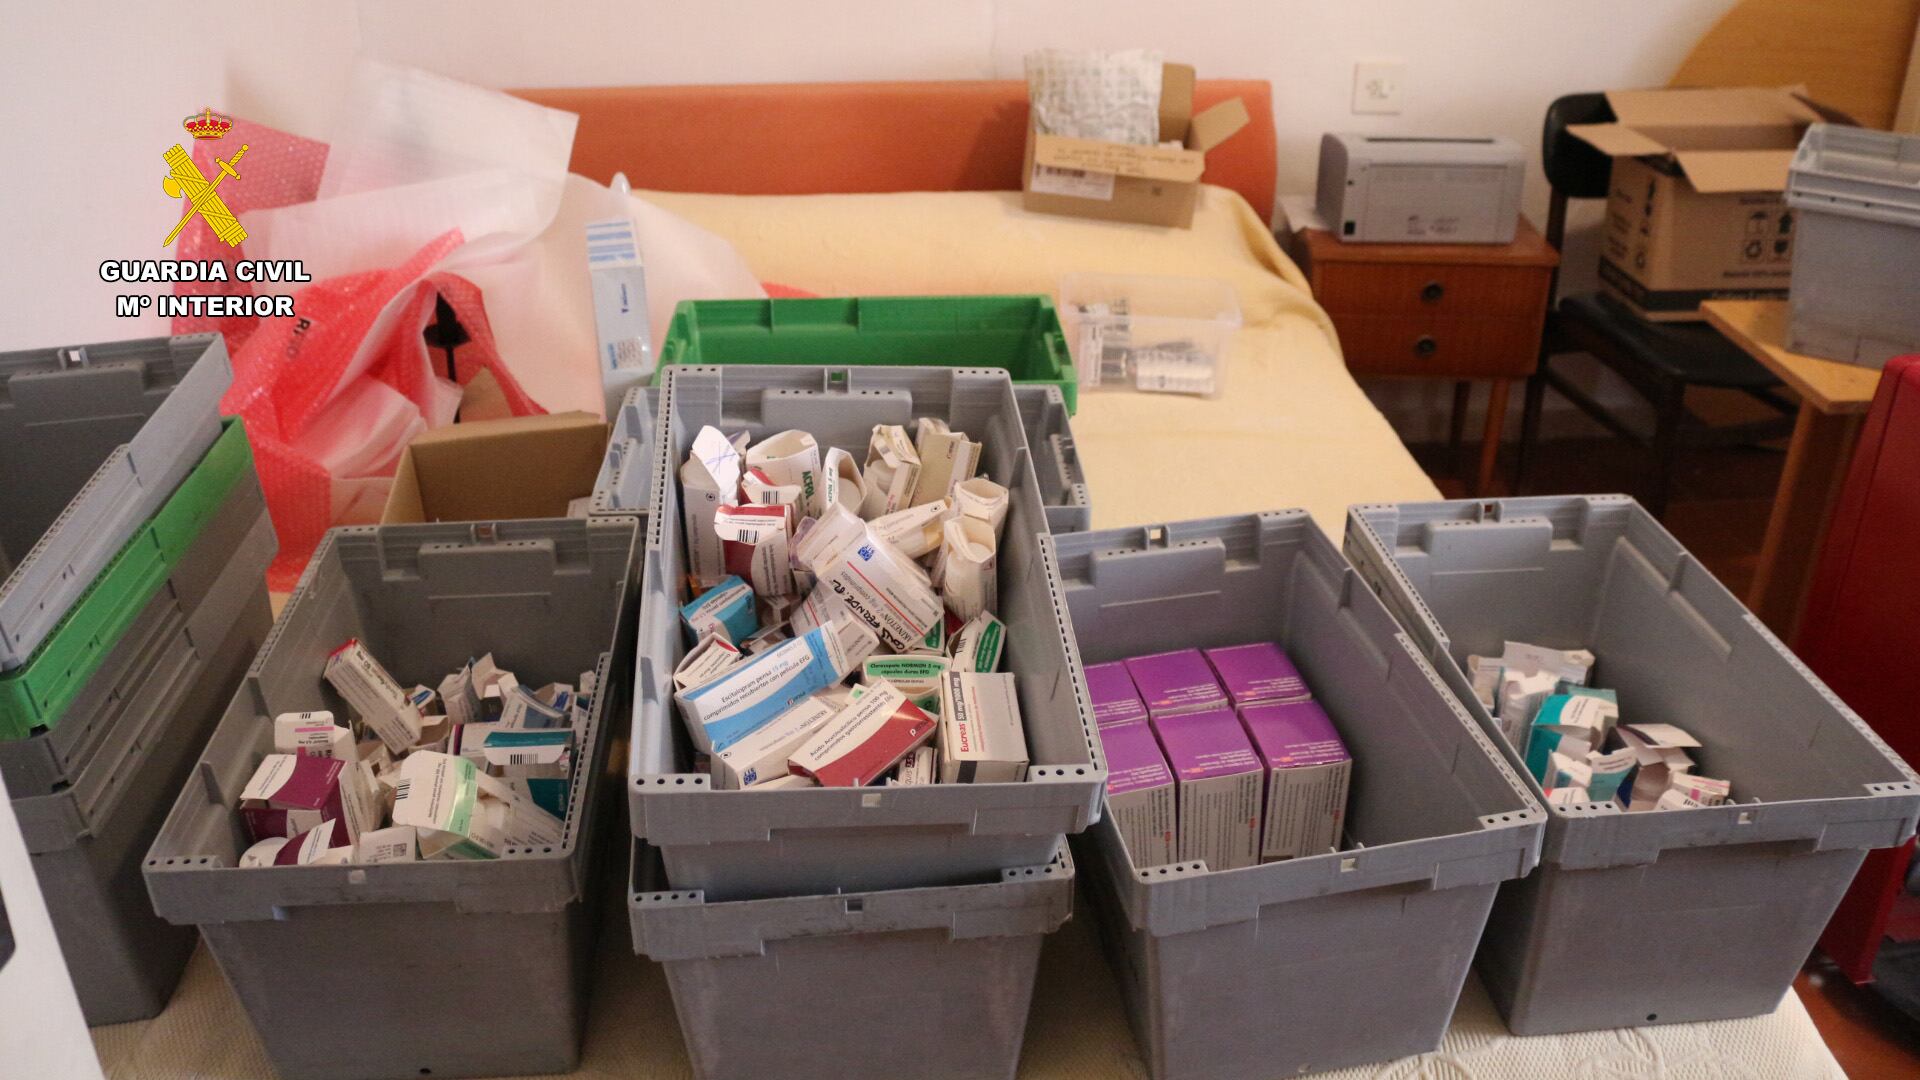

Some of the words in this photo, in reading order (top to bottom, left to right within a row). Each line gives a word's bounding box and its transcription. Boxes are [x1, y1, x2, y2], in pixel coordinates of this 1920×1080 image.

[704, 698, 739, 720] comprimidos
[739, 680, 769, 700] recubiertos
[769, 674, 780, 682] con
[799, 655, 810, 663] EFG
[723, 680, 755, 701] Escitalopram
[756, 670, 772, 683] pensa
[953, 677, 960, 687] mg
[815, 735, 844, 760] comprimidos
